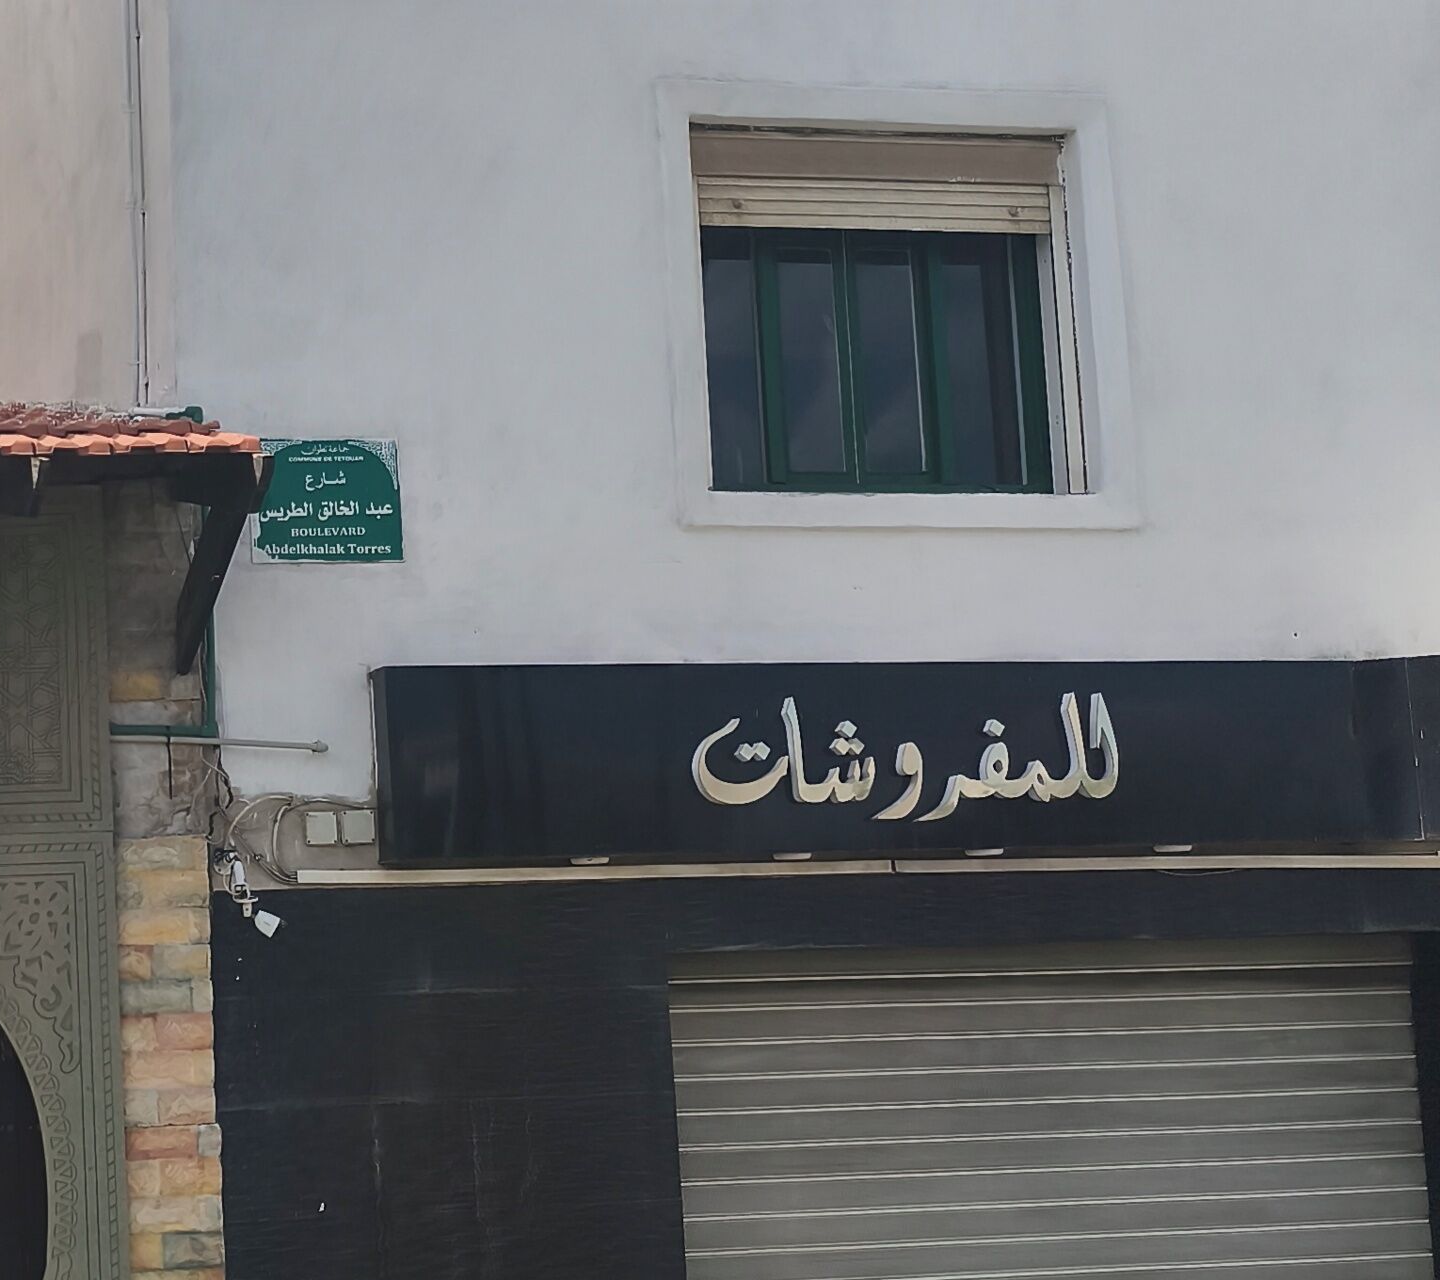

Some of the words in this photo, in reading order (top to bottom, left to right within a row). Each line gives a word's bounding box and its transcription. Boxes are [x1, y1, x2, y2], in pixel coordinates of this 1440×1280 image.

[305, 470, 346, 491] شارع
[260, 501, 313, 522] الطريس
[318, 500, 359, 521] الخالق
[365, 501, 394, 520] عبد
[291, 527, 366, 537] BOULEVARD
[264, 543, 345, 555] Abdelkhalak
[347, 543, 392, 554] Torres
[691, 692, 1119, 822] للمفروشات
